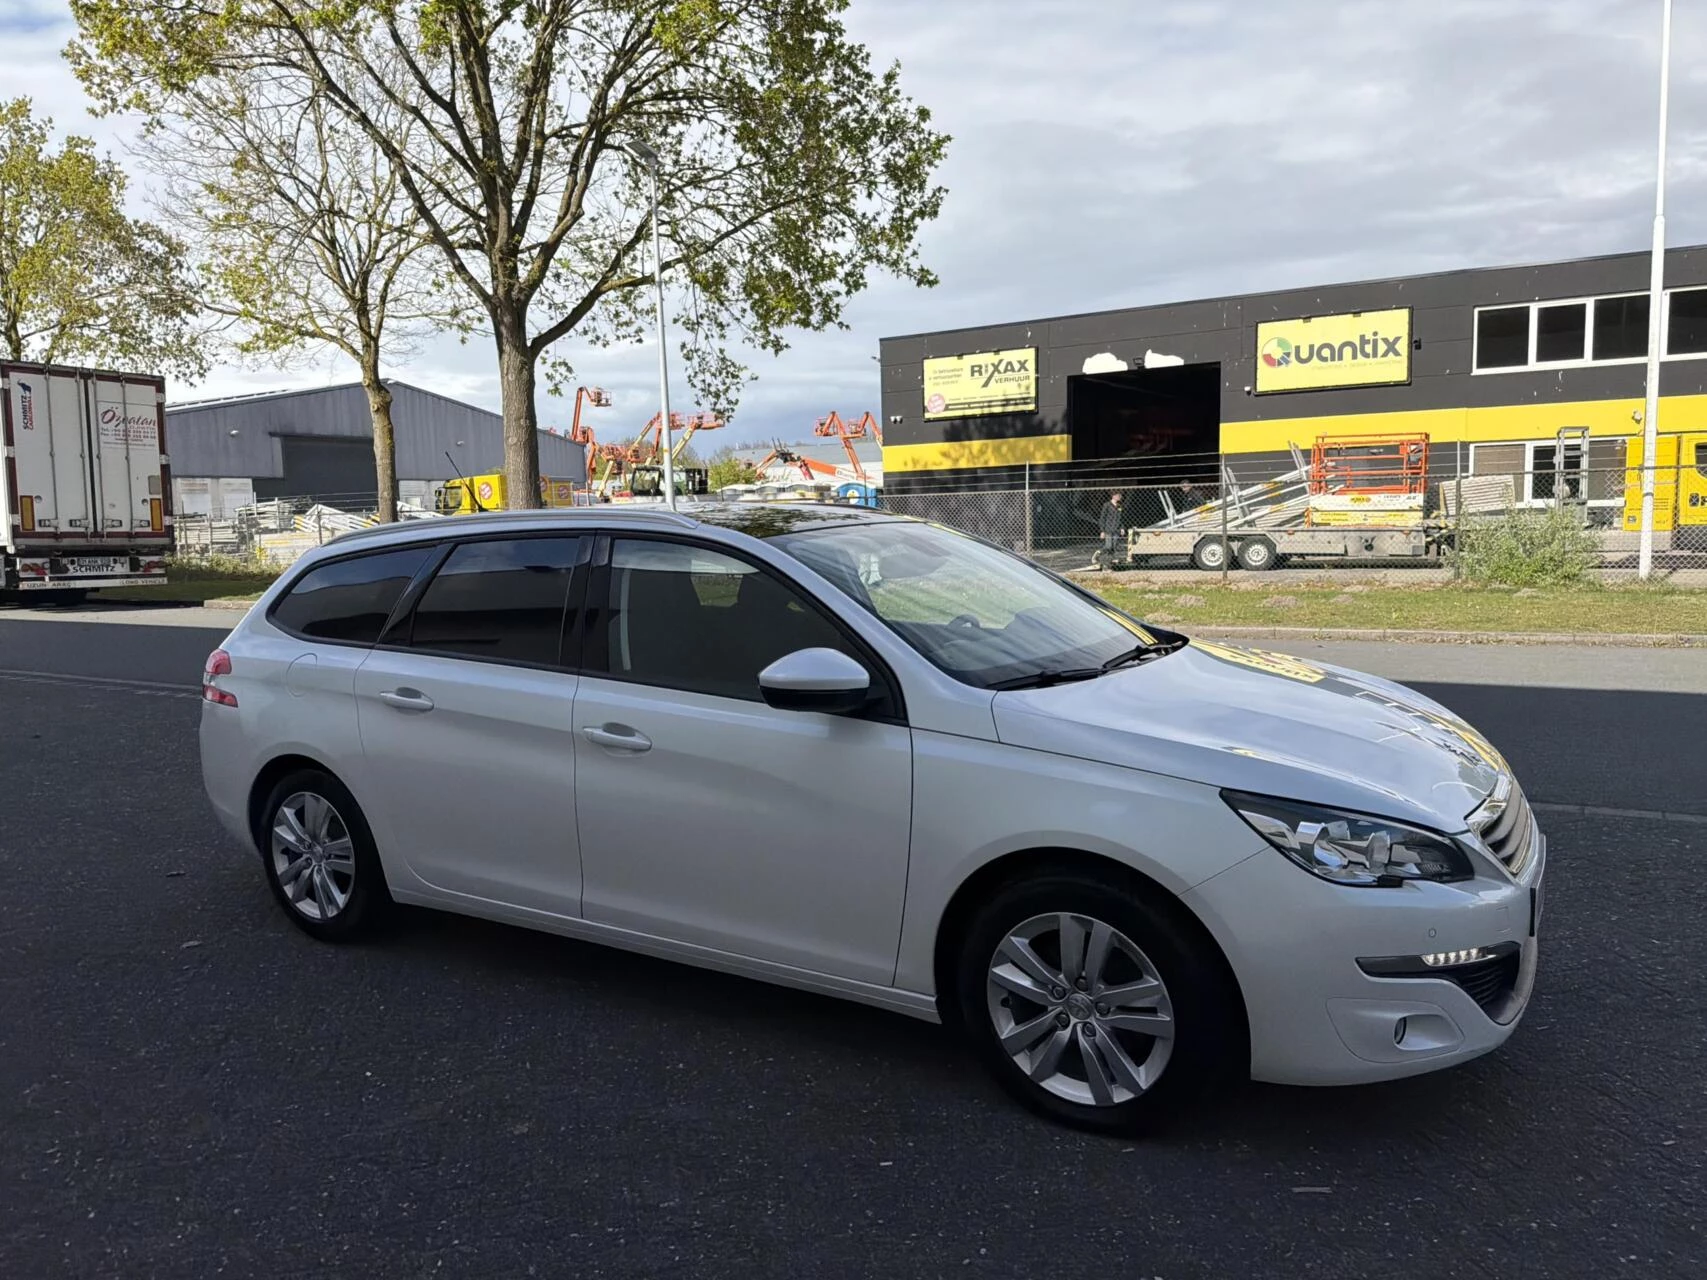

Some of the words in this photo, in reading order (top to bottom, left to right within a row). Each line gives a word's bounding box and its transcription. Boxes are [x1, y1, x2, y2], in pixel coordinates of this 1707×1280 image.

[1262, 331, 1403, 368] Quantix
[994, 375, 1030, 385] VERHUUR
[21, 395, 29, 430] SCHMITZ
[72, 565, 116, 574] SCHMITZ
